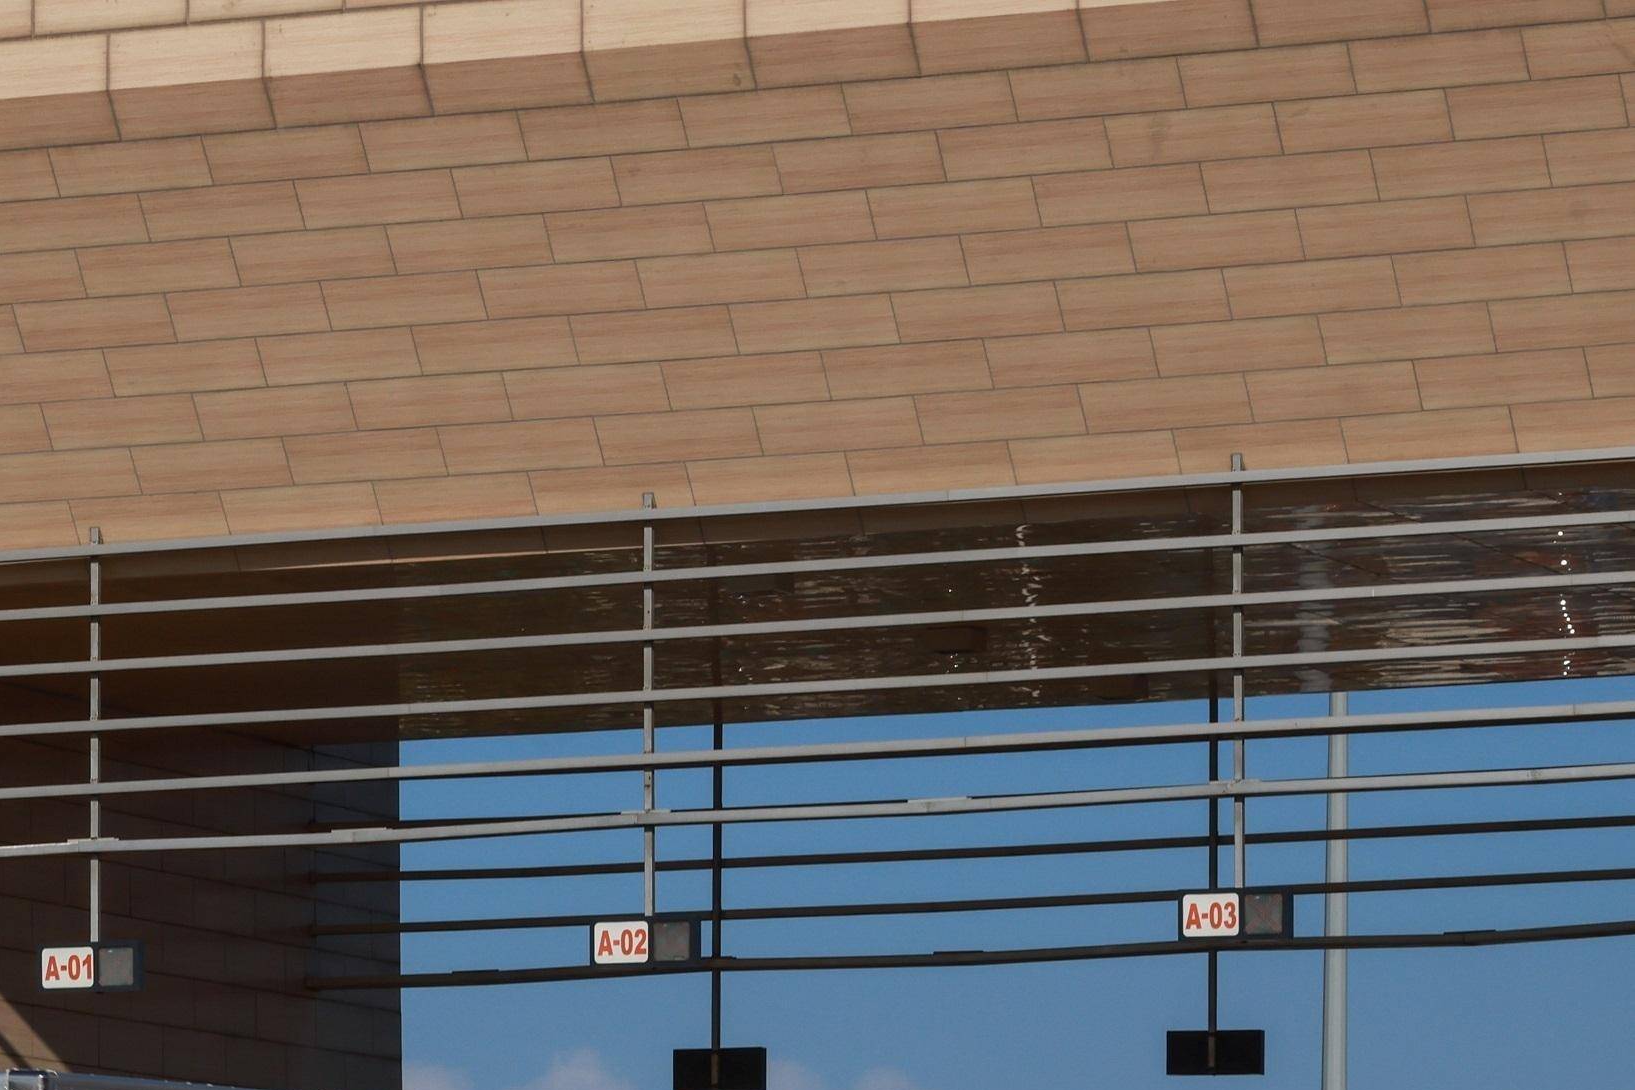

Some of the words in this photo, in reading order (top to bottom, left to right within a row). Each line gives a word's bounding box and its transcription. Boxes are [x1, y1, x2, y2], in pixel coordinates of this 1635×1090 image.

[1185, 901, 1237, 930] A-03
[597, 928, 647, 956] A-02
[45, 953, 92, 981] A-01
